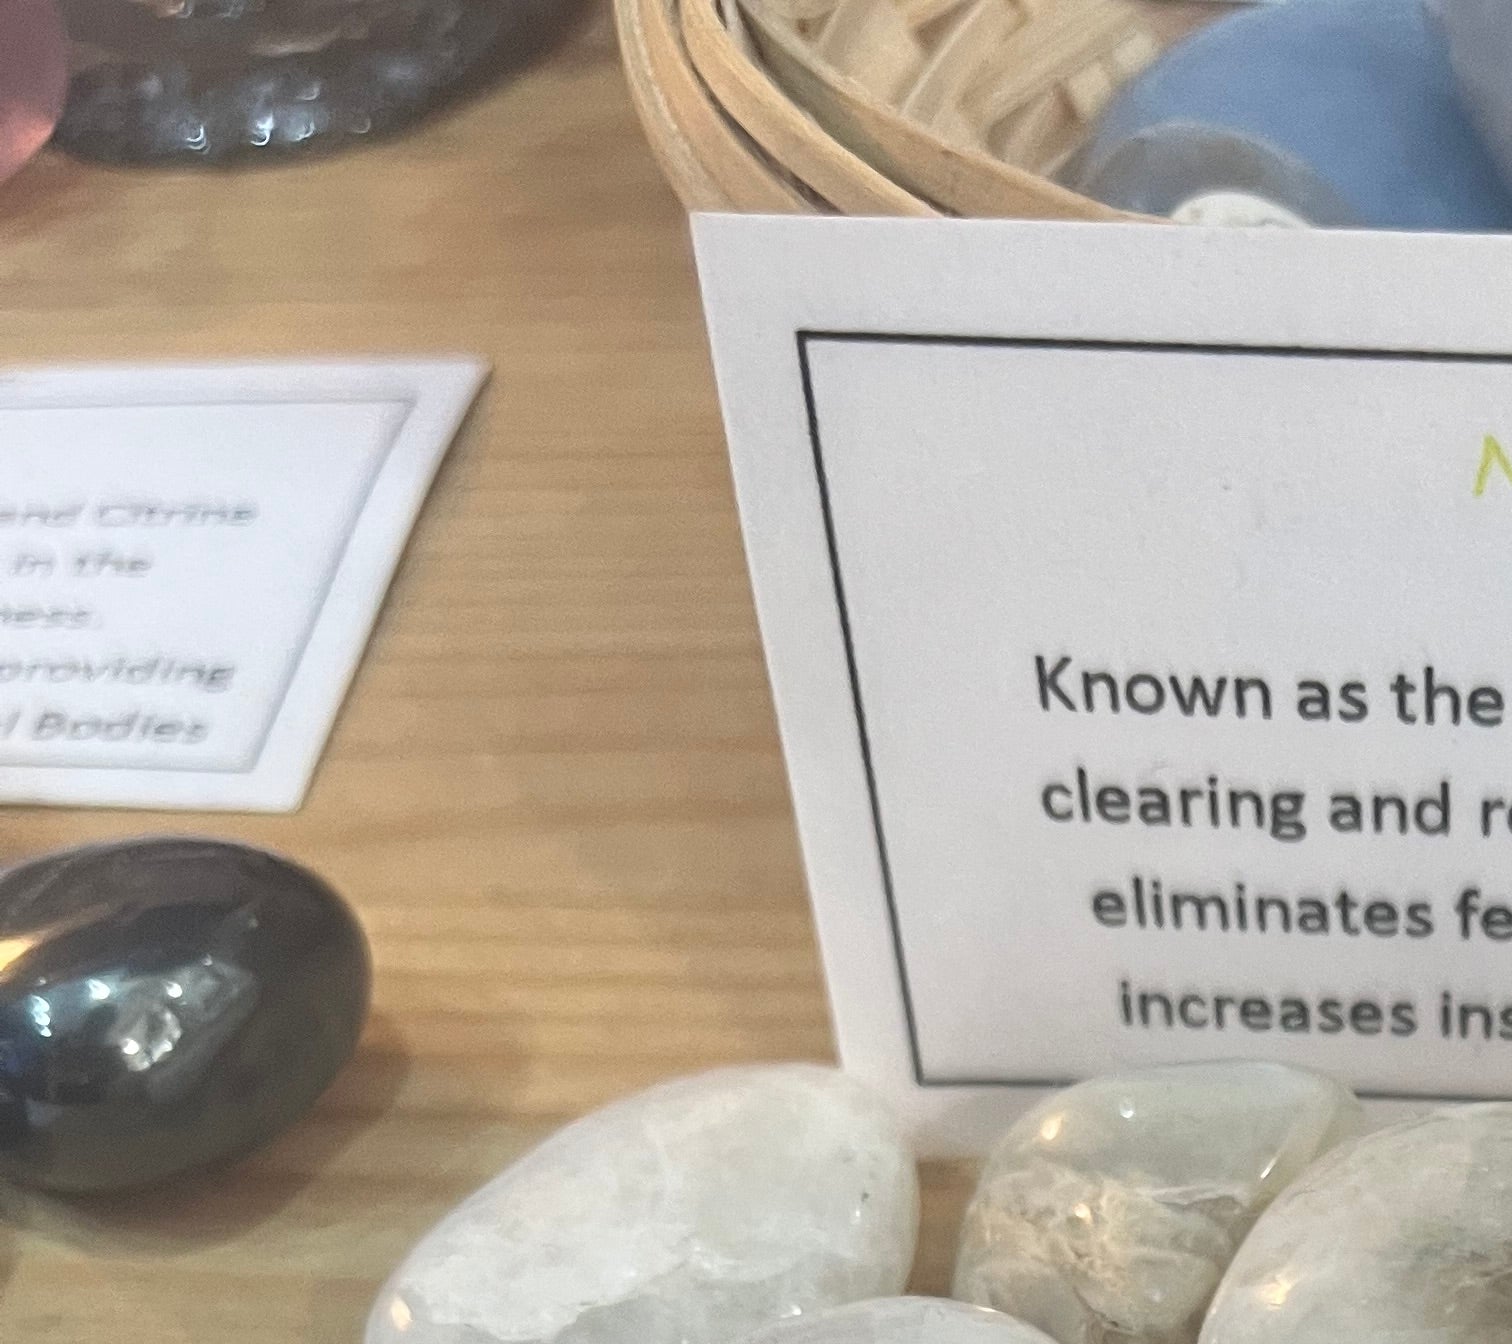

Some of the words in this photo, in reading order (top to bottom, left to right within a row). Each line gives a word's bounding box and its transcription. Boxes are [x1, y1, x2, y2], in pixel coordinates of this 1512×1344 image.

[72, 546, 153, 579] the
[1034, 654, 1273, 725] Known
[1296, 678, 1369, 723] as
[1389, 664, 1506, 728] the
[31, 709, 210, 744] Bodies
[1040, 765, 1307, 843] clearing
[1328, 779, 1451, 837] and
[1091, 874, 1435, 938] eliminates
[1120, 979, 1418, 1037] increases
